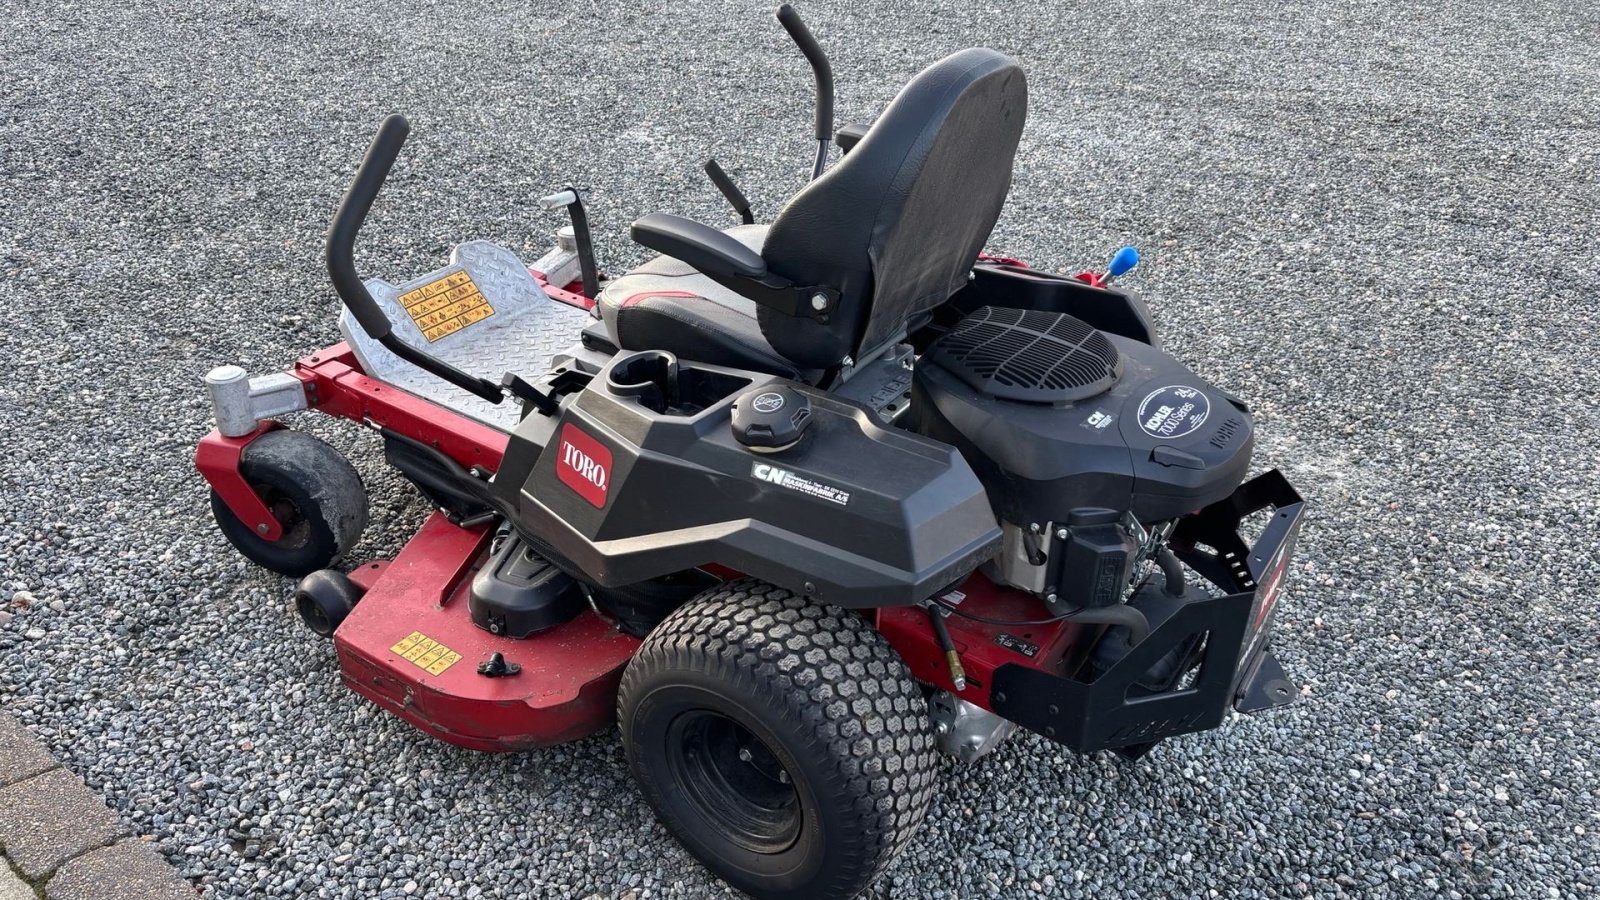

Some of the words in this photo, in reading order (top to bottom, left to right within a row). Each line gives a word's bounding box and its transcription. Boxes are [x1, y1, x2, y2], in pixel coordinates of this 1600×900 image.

[1144, 405, 1175, 431] KOHLER
[1157, 413, 1181, 436] 7000
[1171, 402, 1195, 421] Series
[754, 464, 786, 485] CN
